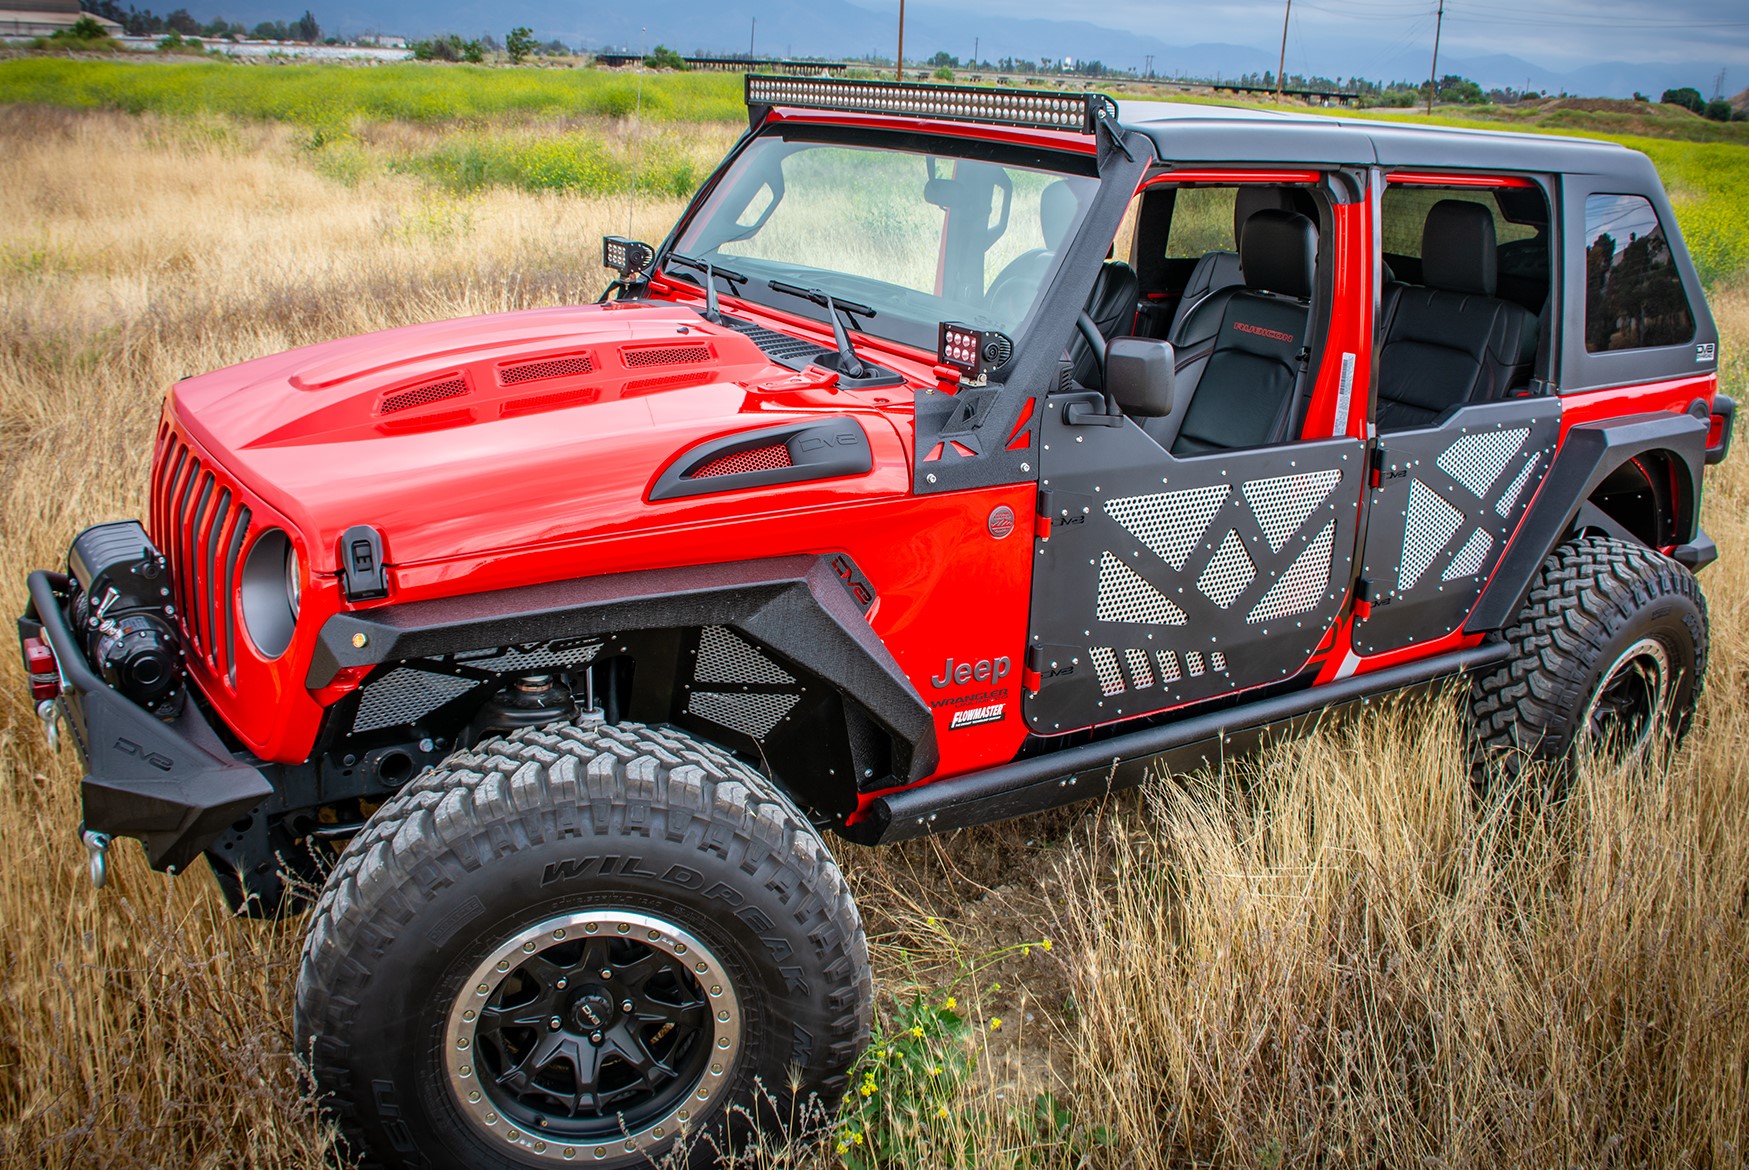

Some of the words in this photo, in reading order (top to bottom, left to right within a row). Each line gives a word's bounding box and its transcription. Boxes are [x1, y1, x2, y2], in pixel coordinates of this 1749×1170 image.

[1233, 321, 1293, 342] RUBICON
[798, 432, 859, 452] DV8
[832, 555, 873, 606] DV8
[931, 655, 1011, 689] Jeep
[950, 703, 1006, 729] FLOWMASTER
[113, 736, 174, 772] DV8
[539, 855, 811, 997] WILDPEAK
[582, 1004, 600, 1025] DV8
